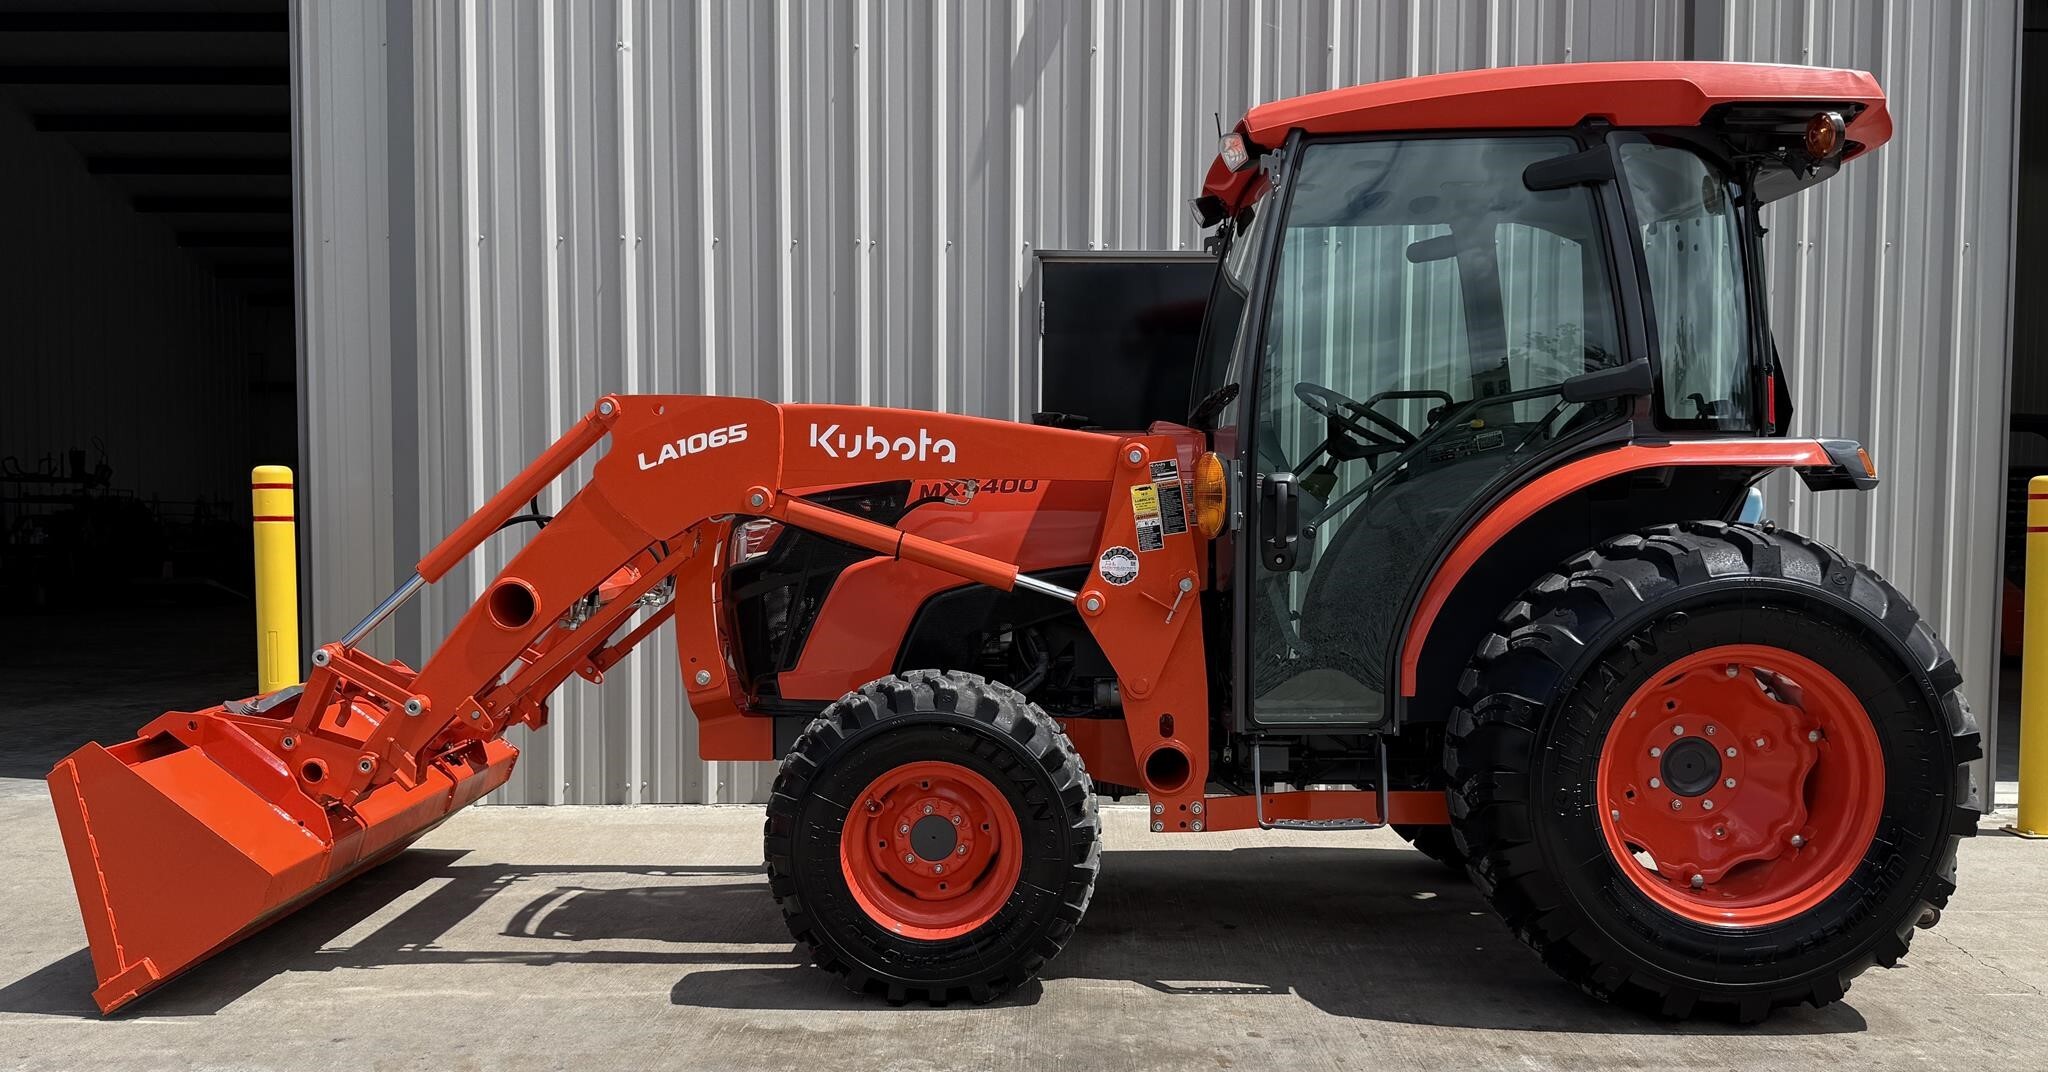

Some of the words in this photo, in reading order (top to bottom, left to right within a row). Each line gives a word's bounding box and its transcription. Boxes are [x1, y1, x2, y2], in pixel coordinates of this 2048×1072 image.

[638, 423, 748, 471] LA1065
[809, 423, 956, 463] Kubota
[969, 731, 1053, 822] TITAN
